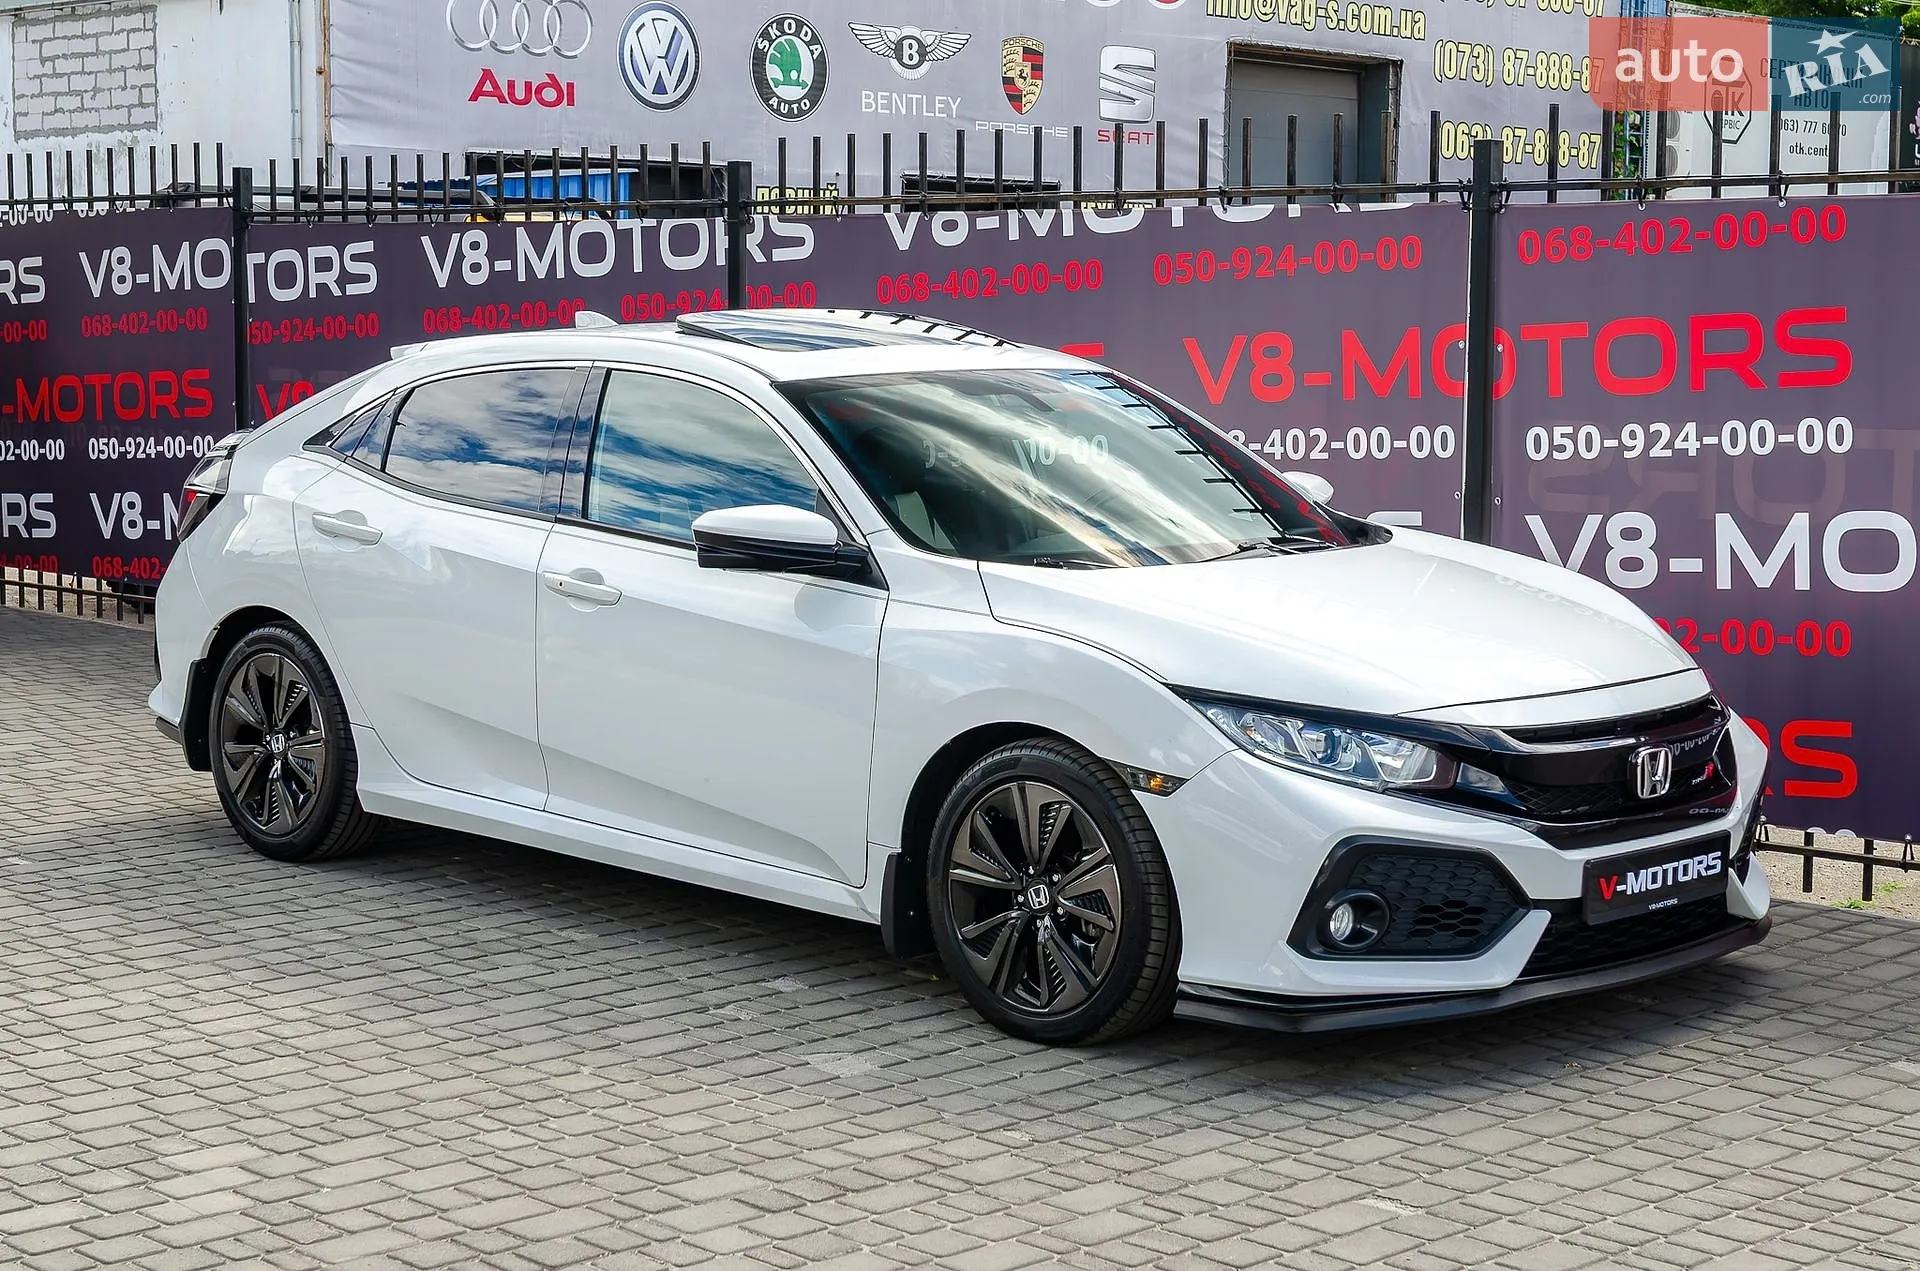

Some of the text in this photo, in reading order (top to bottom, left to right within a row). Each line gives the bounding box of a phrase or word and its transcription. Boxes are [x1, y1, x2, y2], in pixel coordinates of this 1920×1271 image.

[468, 67, 576, 108] Audi
[1434, 39, 1605, 95] (073) 87-888-87
[768, 96, 811, 115] AUTO
[861, 91, 962, 118] BENTLEY
[1803, 120, 1818, 134] 777
[975, 120, 1068, 138] PORSCHE
[1502, 125, 1601, 169] 87-88-87
[1789, 141, 1830, 157] otk.cent
[420, 216, 816, 289] V8-MOTORS
[1517, 203, 1848, 266] 068-402-00-00
[79, 237, 378, 304] V8-MOTORS
[877, 258, 1104, 305] 068-402-00-00
[1153, 234, 1423, 286] 050-924-00-00
[81, 307, 379, 345] 068-402-00-00 50-924-00-00
[423, 298, 585, 333] 068-402-00-00
[1182, 305, 1854, 405] V8-MOTORS
[88, 435, 215, 460] 050-924-00-00
[1525, 416, 1854, 461] 050-924-00-00
[1, 492, 57, 538] RS
[1523, 510, 1918, 593] V8-MO
[1599, 851, 1722, 900] V-MOTORS
